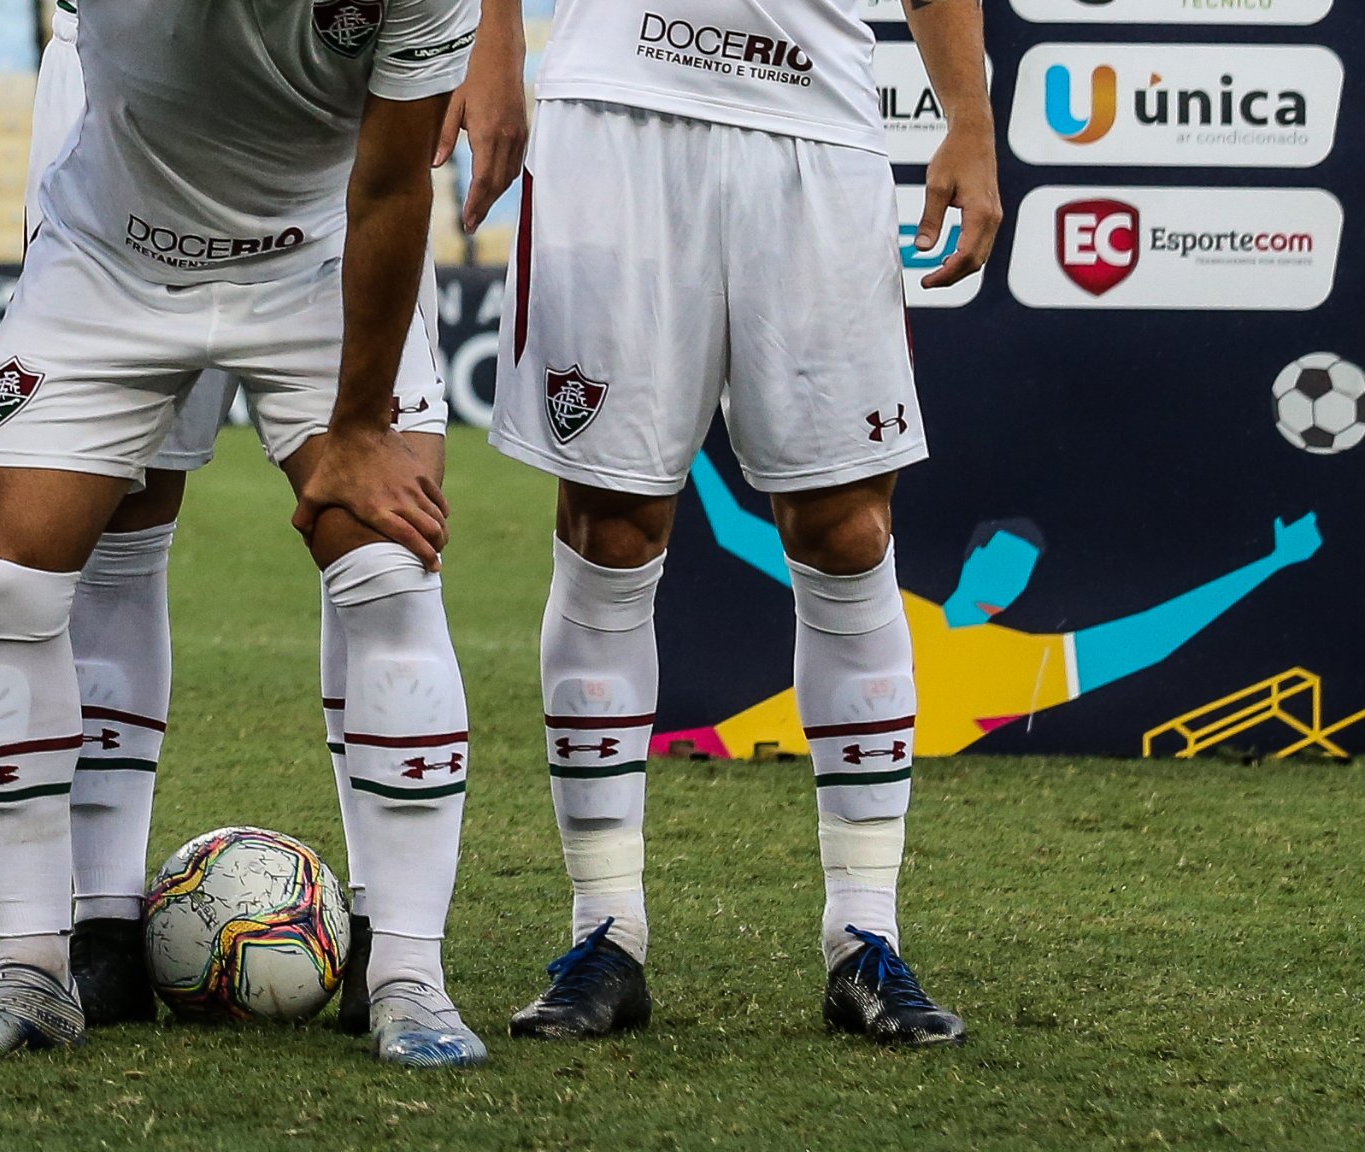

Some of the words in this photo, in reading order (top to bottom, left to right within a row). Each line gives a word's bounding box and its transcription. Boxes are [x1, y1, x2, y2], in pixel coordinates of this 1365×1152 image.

[639, 11, 814, 72] DOCERIO
[636, 45, 732, 75] FRETAMENTO
[736, 65, 746, 77] E
[750, 67, 812, 88] TURISMO
[1134, 72, 1307, 127] única
[1196, 131, 1309, 146] condicionado
[124, 237, 210, 268] FRETAMEN
[126, 214, 305, 259] DOCERIO
[1063, 212, 1133, 267] EC
[1150, 226, 1314, 257] Esportecom
